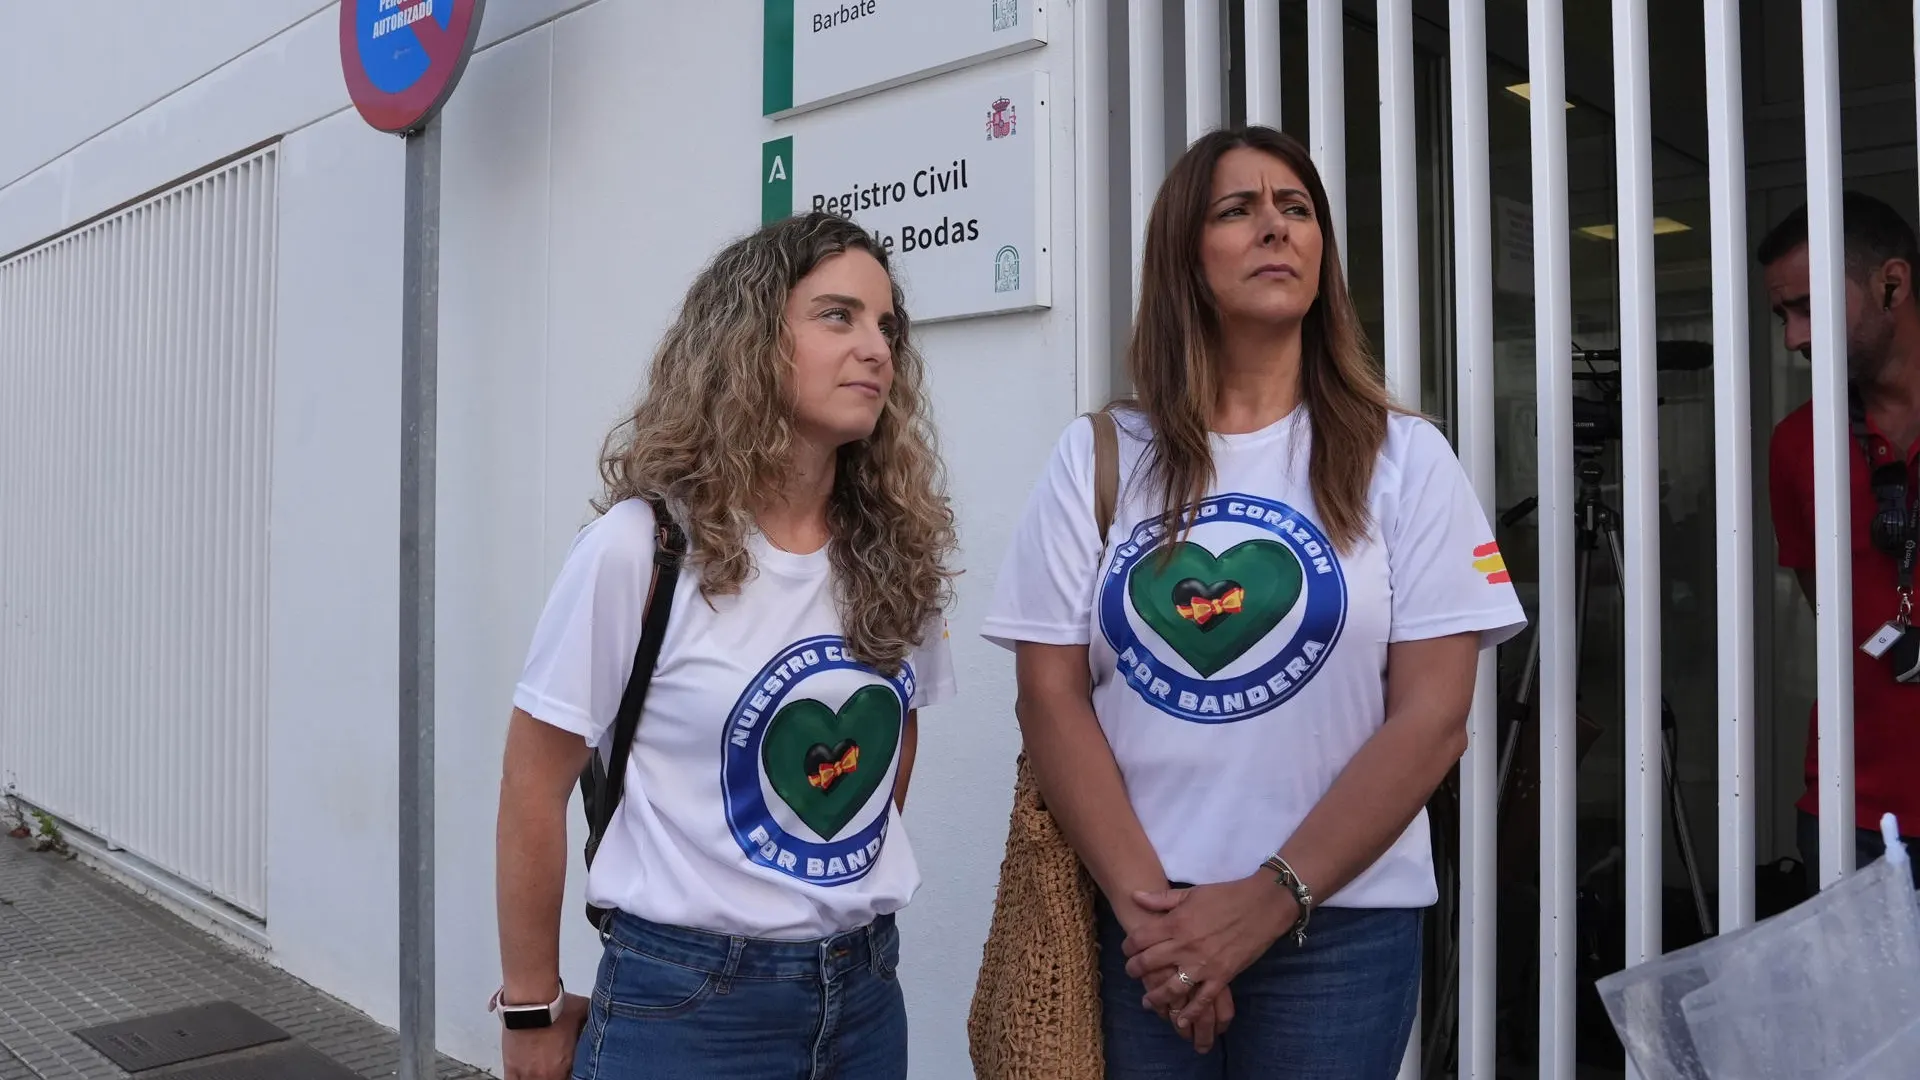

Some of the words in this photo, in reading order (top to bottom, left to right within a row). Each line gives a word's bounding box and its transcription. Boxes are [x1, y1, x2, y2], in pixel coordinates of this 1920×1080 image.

[372, 0, 433, 39] AUTORIZADO
[813, 0, 876, 33] Barbate
[812, 182, 906, 220] Registro
[912, 159, 968, 198] Civil
[902, 216, 980, 253] Bodas
[1111, 504, 1219, 575] NUESRO
[1227, 501, 1333, 575] CORAZON
[730, 648, 820, 748] NUESTRO
[1119, 646, 1172, 701] POR
[1177, 639, 1326, 714] BANDERA
[747, 824, 798, 873] POR
